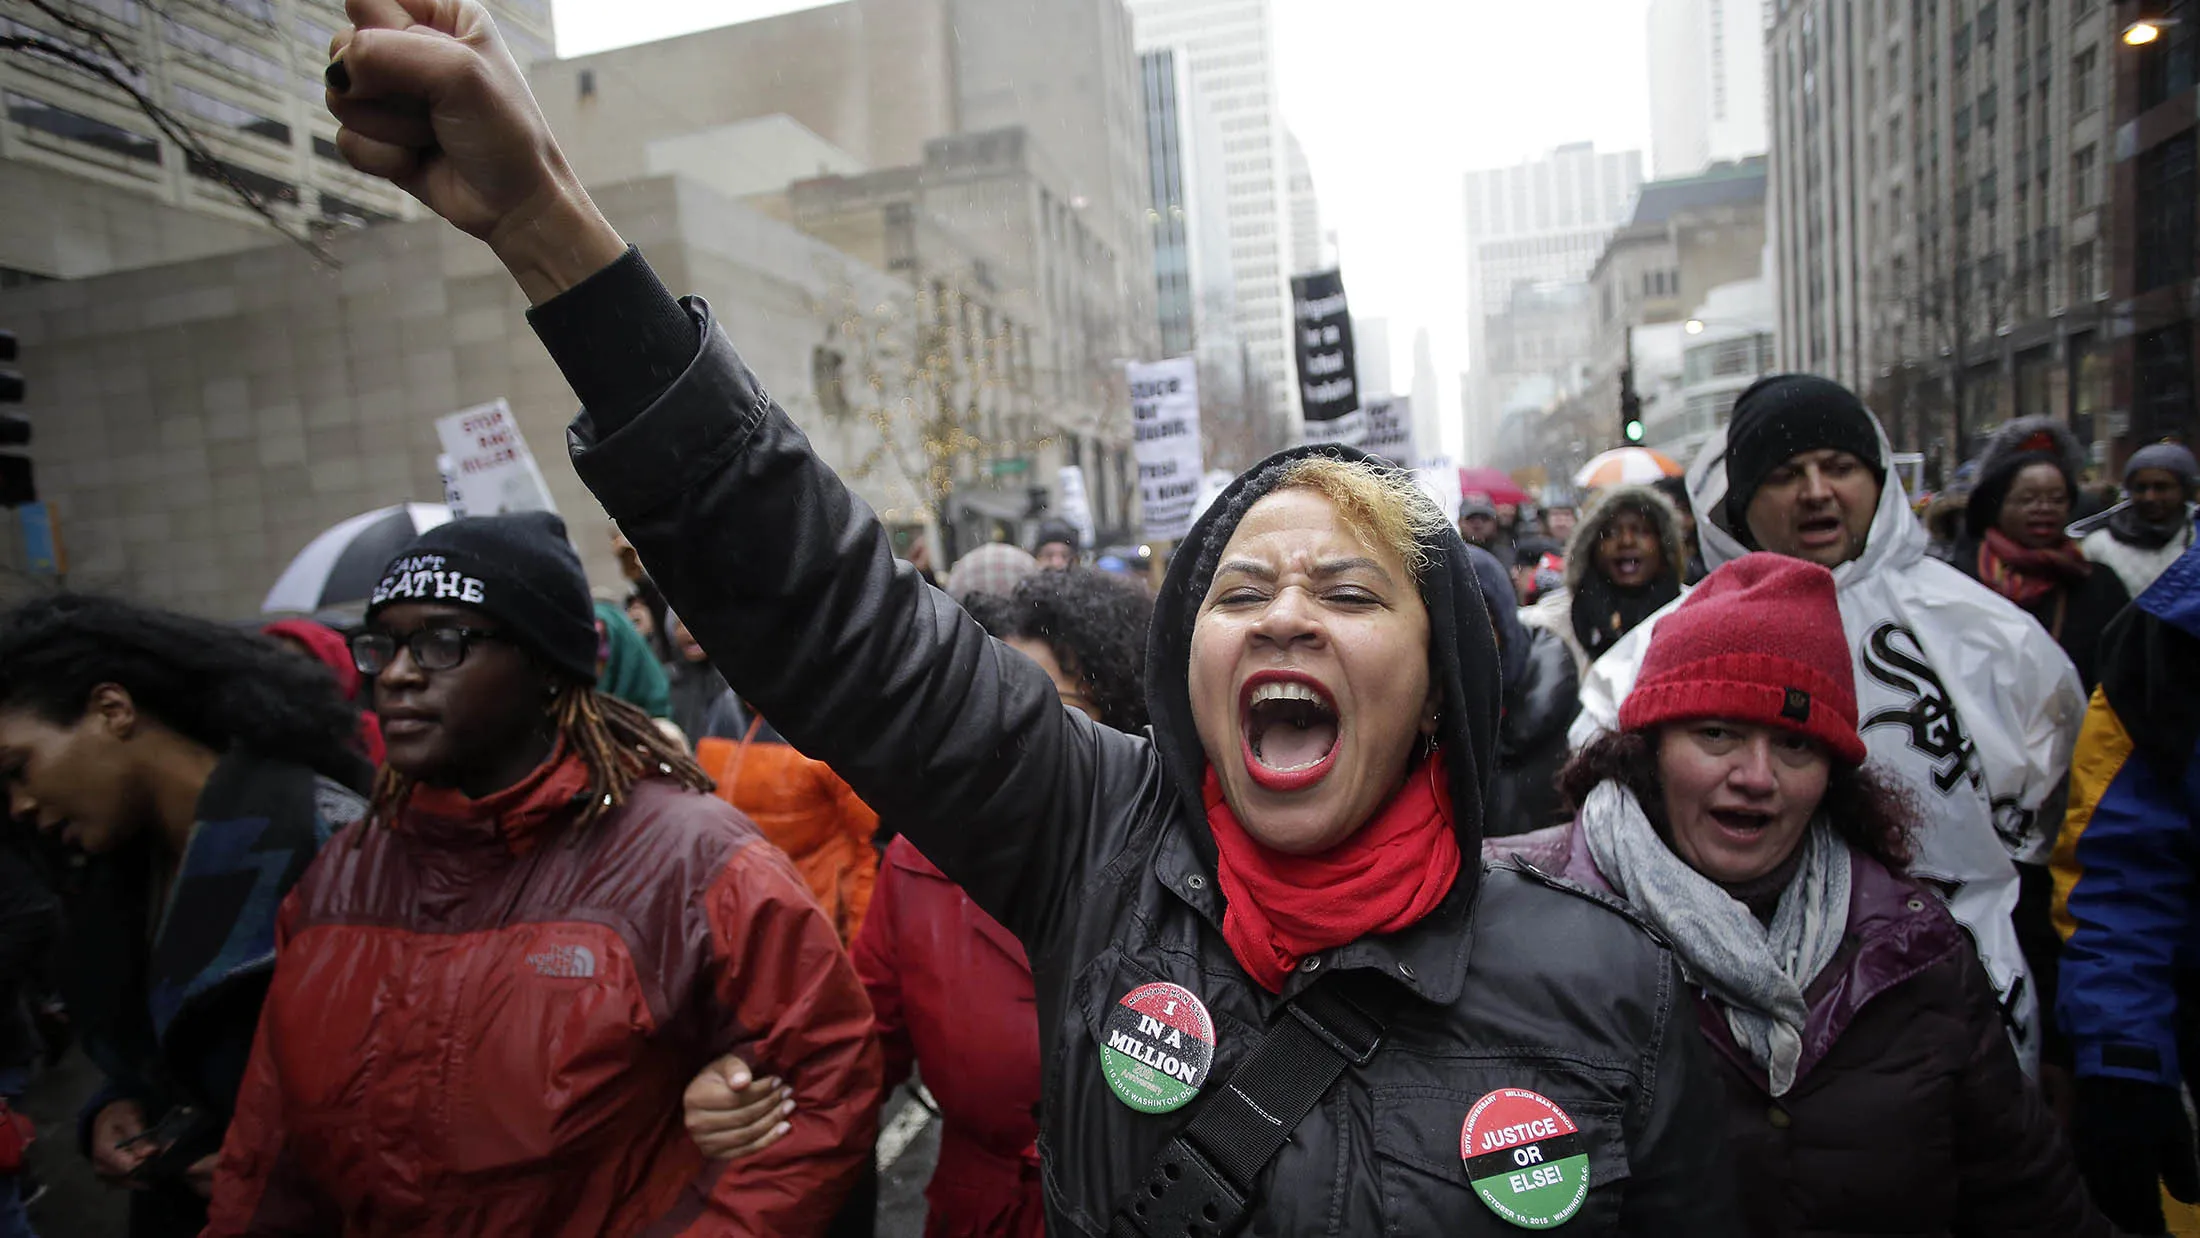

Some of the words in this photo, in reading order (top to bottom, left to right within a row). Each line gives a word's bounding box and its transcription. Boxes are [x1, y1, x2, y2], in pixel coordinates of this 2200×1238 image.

[1128, 988, 1167, 1005] MILLION
[1170, 990, 1190, 1004] MAN
[1138, 1015, 1165, 1040] IN
[1164, 1029, 1181, 1049] A
[1104, 1048, 1112, 1066] OCT
[1109, 1069, 1117, 1079] 10
[1114, 1079, 1129, 1096] 2015
[1107, 1030, 1198, 1084] MILLION
[1467, 1095, 1497, 1133] ANNIVERSARY
[1504, 1091, 1534, 1100] MILLION
[1535, 1096, 1551, 1108] MAN
[1552, 1107, 1574, 1131] MARCH
[1481, 1117, 1558, 1150] JUSTICE
[1513, 1145, 1543, 1166] OR
[1509, 1165, 1564, 1194] ELSE!
[1482, 1189, 1514, 1218] OCTOBER
[1530, 1217, 1548, 1225] 2015
[1553, 1184, 1587, 1221] WASHINGTON,
